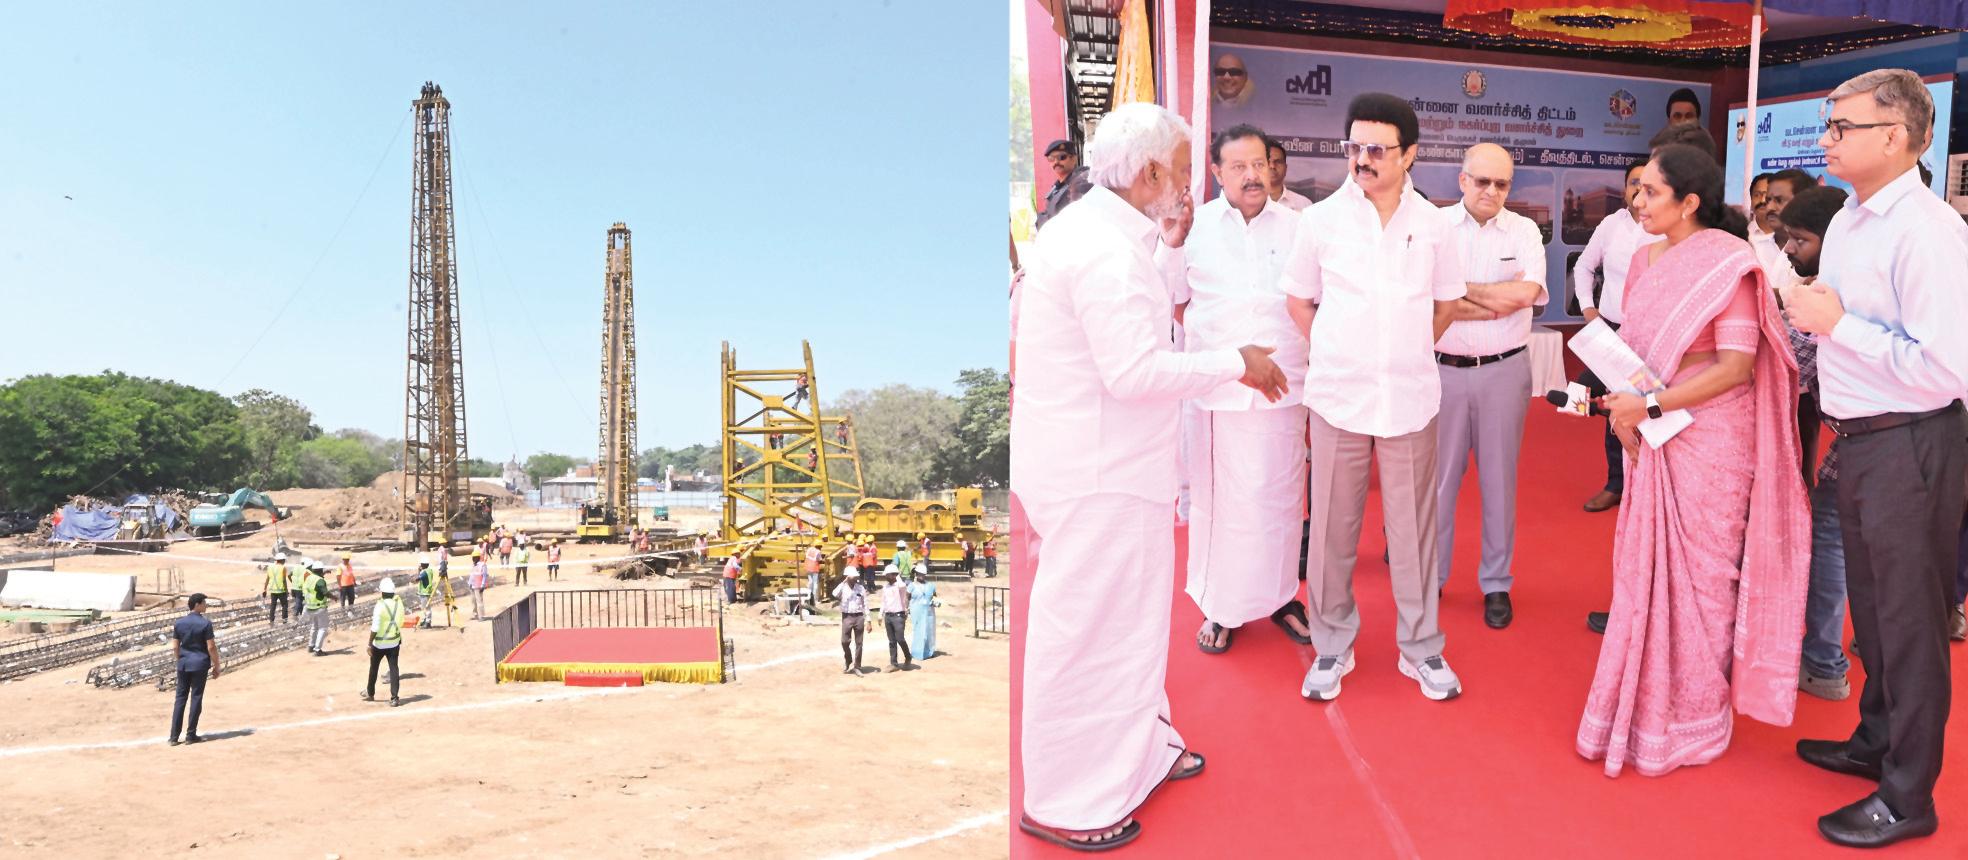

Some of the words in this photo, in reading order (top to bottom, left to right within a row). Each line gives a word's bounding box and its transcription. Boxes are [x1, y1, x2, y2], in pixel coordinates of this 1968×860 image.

[1286, 64, 1331, 96] CMDA
[1408, 97, 1459, 114] ன்னை
[1466, 102, 1531, 120] வளர்ச்சித்
[1538, 106, 1576, 120] திட்டம்
[1556, 126, 1583, 138] துறை
[1278, 138, 1315, 153] வீன
[1541, 149, 1594, 165] தீவுத்திடல்,
